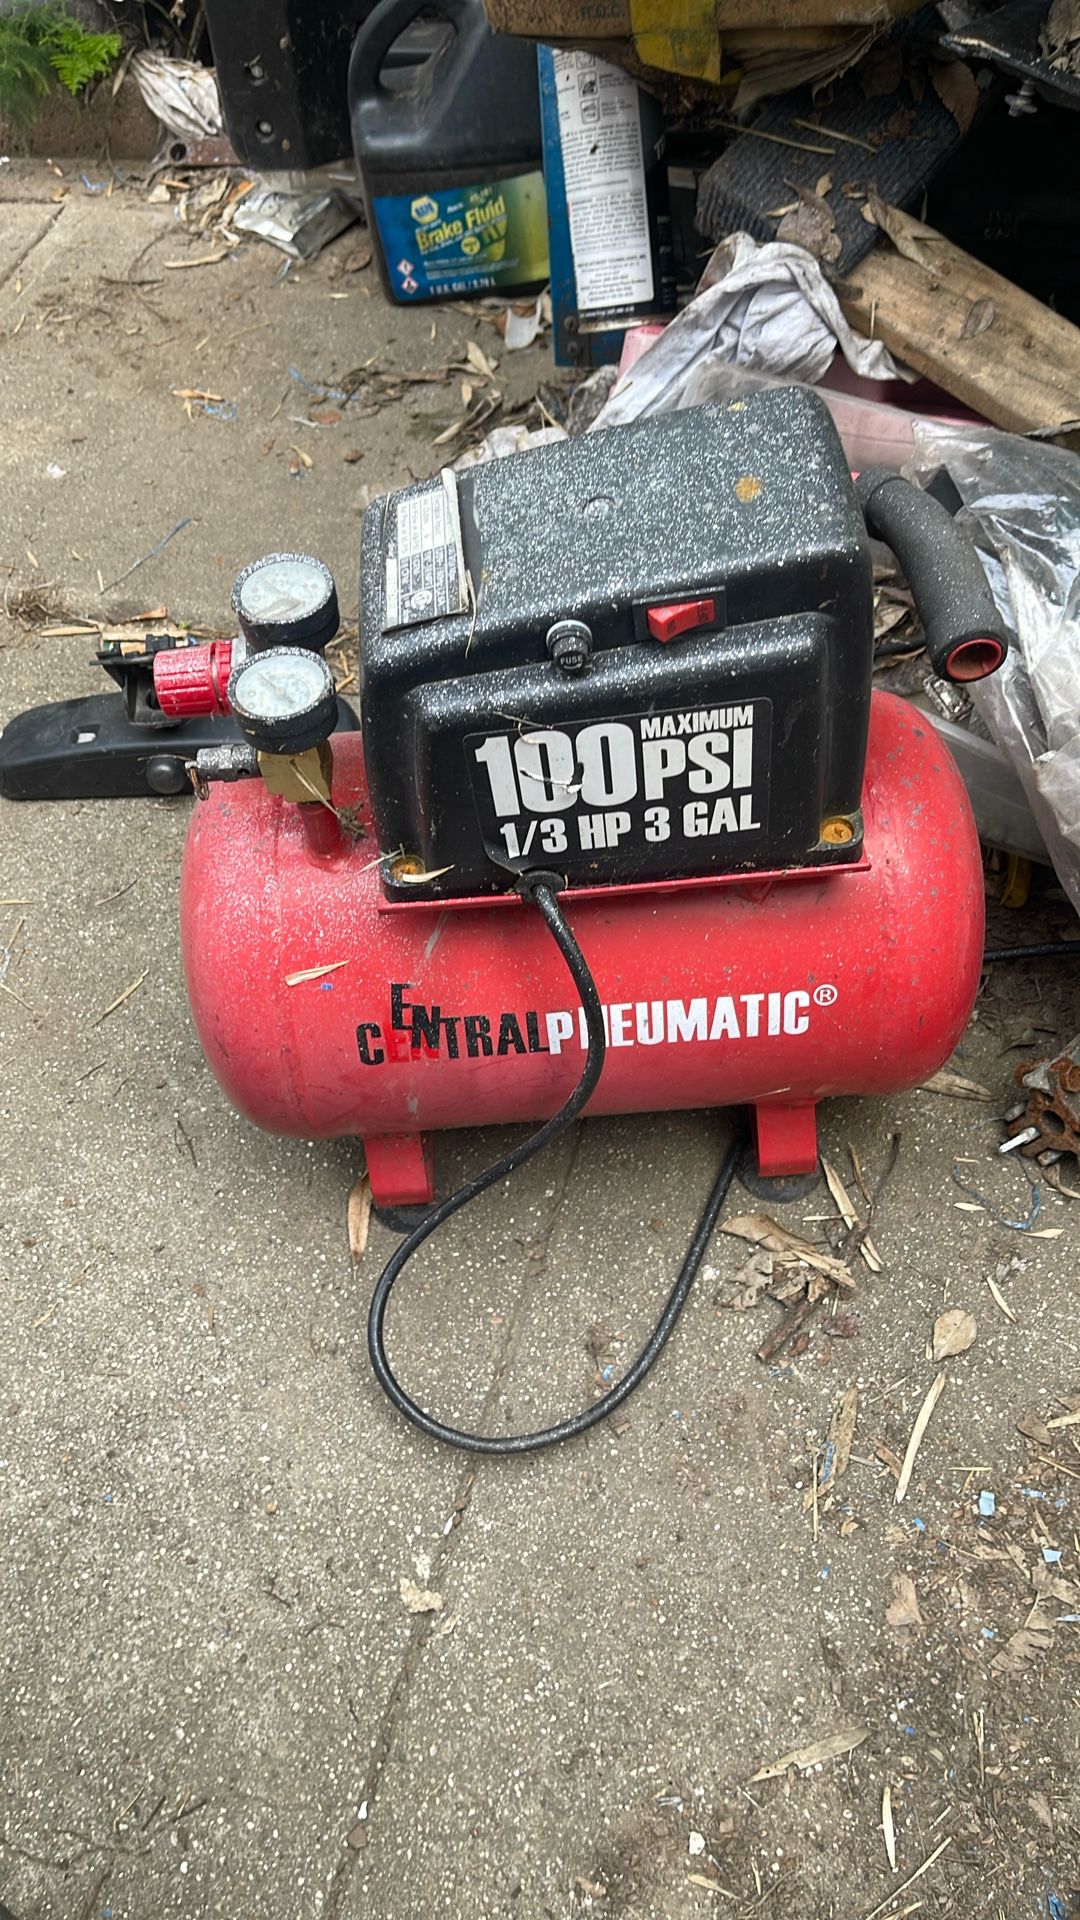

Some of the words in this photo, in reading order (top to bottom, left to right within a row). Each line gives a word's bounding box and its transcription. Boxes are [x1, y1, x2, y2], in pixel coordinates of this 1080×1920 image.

[415, 219, 463, 251] Brake
[465, 194, 506, 231] Fluid
[560, 655, 583, 666] FUSE
[640, 705, 754, 740] MAXIMUM
[475, 722, 638, 817] 100
[642, 727, 753, 801] PSI
[499, 818, 568, 859] 1/3
[577, 811, 632, 850] HP
[644, 806, 671, 842] 3
[683, 794, 761, 838] GAL
[356, 983, 552, 1065] CENTRAL
